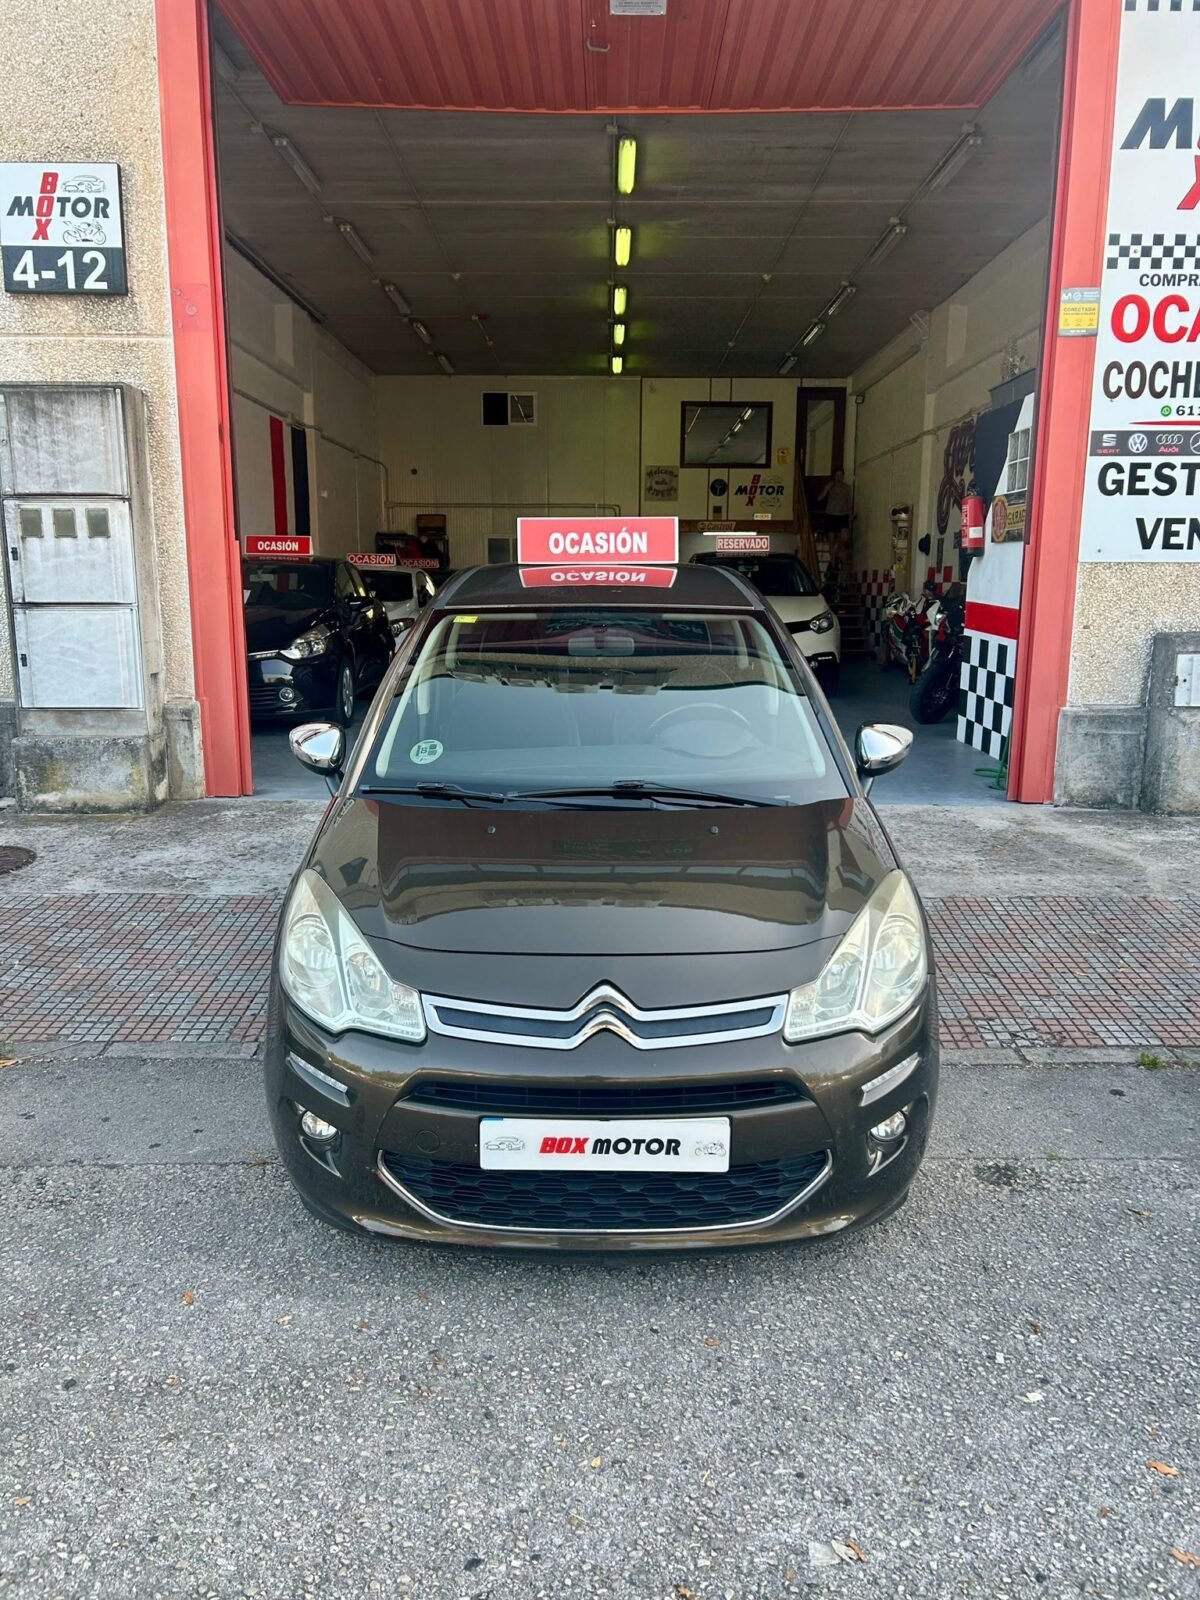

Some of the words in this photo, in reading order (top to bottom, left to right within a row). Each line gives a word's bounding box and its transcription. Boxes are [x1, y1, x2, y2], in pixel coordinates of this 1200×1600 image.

[1120, 98, 1200, 150] M
[13, 249, 108, 290] 4-12
[1139, 274, 1200, 287] COMPR
[1158, 445, 1179, 453] Audi
[258, 540, 299, 551] OCASIÓN
[549, 527, 648, 554] OCASIÓN
[717, 538, 768, 549] RESERVADO
[539, 1137, 590, 1154] BOX
[592, 1138, 681, 1156] MOTOR
